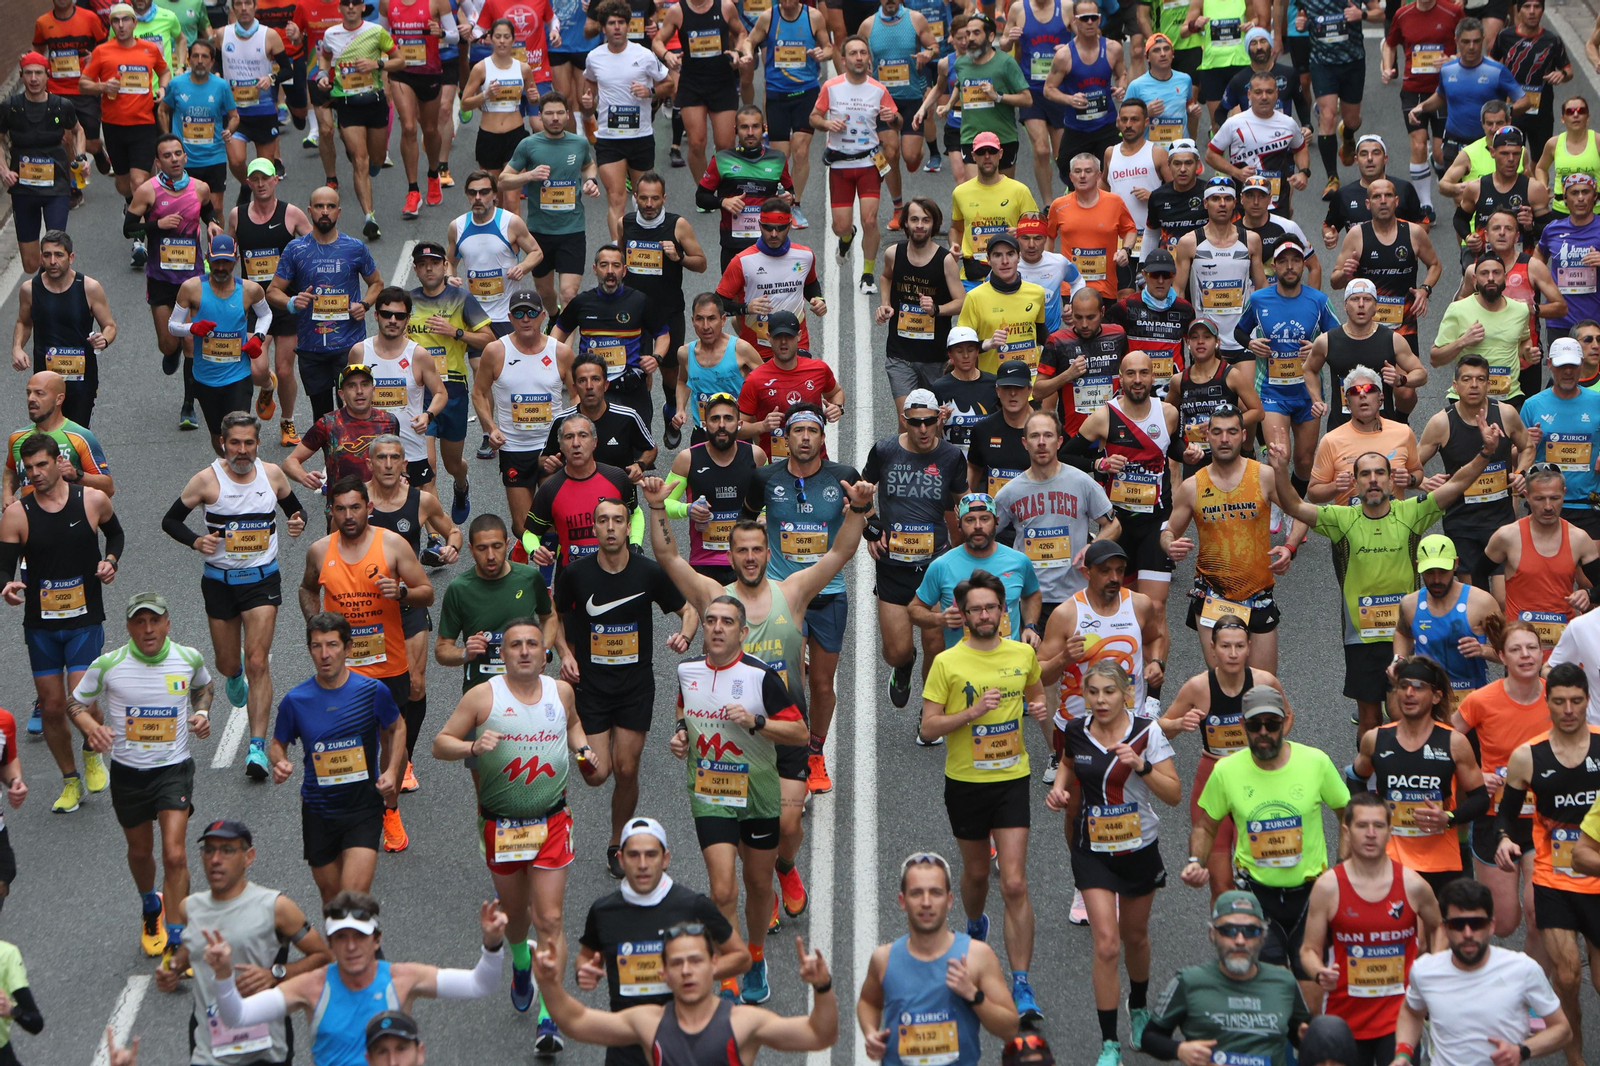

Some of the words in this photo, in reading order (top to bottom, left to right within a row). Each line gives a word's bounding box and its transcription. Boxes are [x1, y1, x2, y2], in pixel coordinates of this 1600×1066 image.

[1112, 167, 1148, 178] Deluka
[1011, 341, 1032, 349] ZURICH
[1088, 354, 1117, 362] PABLO
[1129, 474, 1153, 482] ZURICH
[887, 484, 942, 500] PEAKS
[1010, 492, 1044, 522] TEXAS
[1048, 491, 1078, 520] TECH
[1202, 505, 1223, 513] VIANA
[54, 579, 79, 588] ZURICH
[1219, 605, 1234, 614] 5290
[990, 722, 1015, 733] ZURICH
[328, 739, 356, 749] ZURICH
[991, 739, 1007, 748] 4208
[330, 755, 347, 764] 4615
[714, 764, 743, 772] ZURICH
[1388, 775, 1441, 789] PACER
[713, 787, 741, 796] ALMAGRO
[1104, 806, 1132, 816] ZURICH
[1265, 819, 1296, 829] ZURICH
[1268, 836, 1286, 845] 4947
[1336, 933, 1363, 942] SAN
[1370, 926, 1415, 942] PEDRO
[1367, 947, 1398, 956] ZURICH
[915, 1013, 949, 1022] ZURICH
[1230, 1055, 1265, 1066] ZURICH
